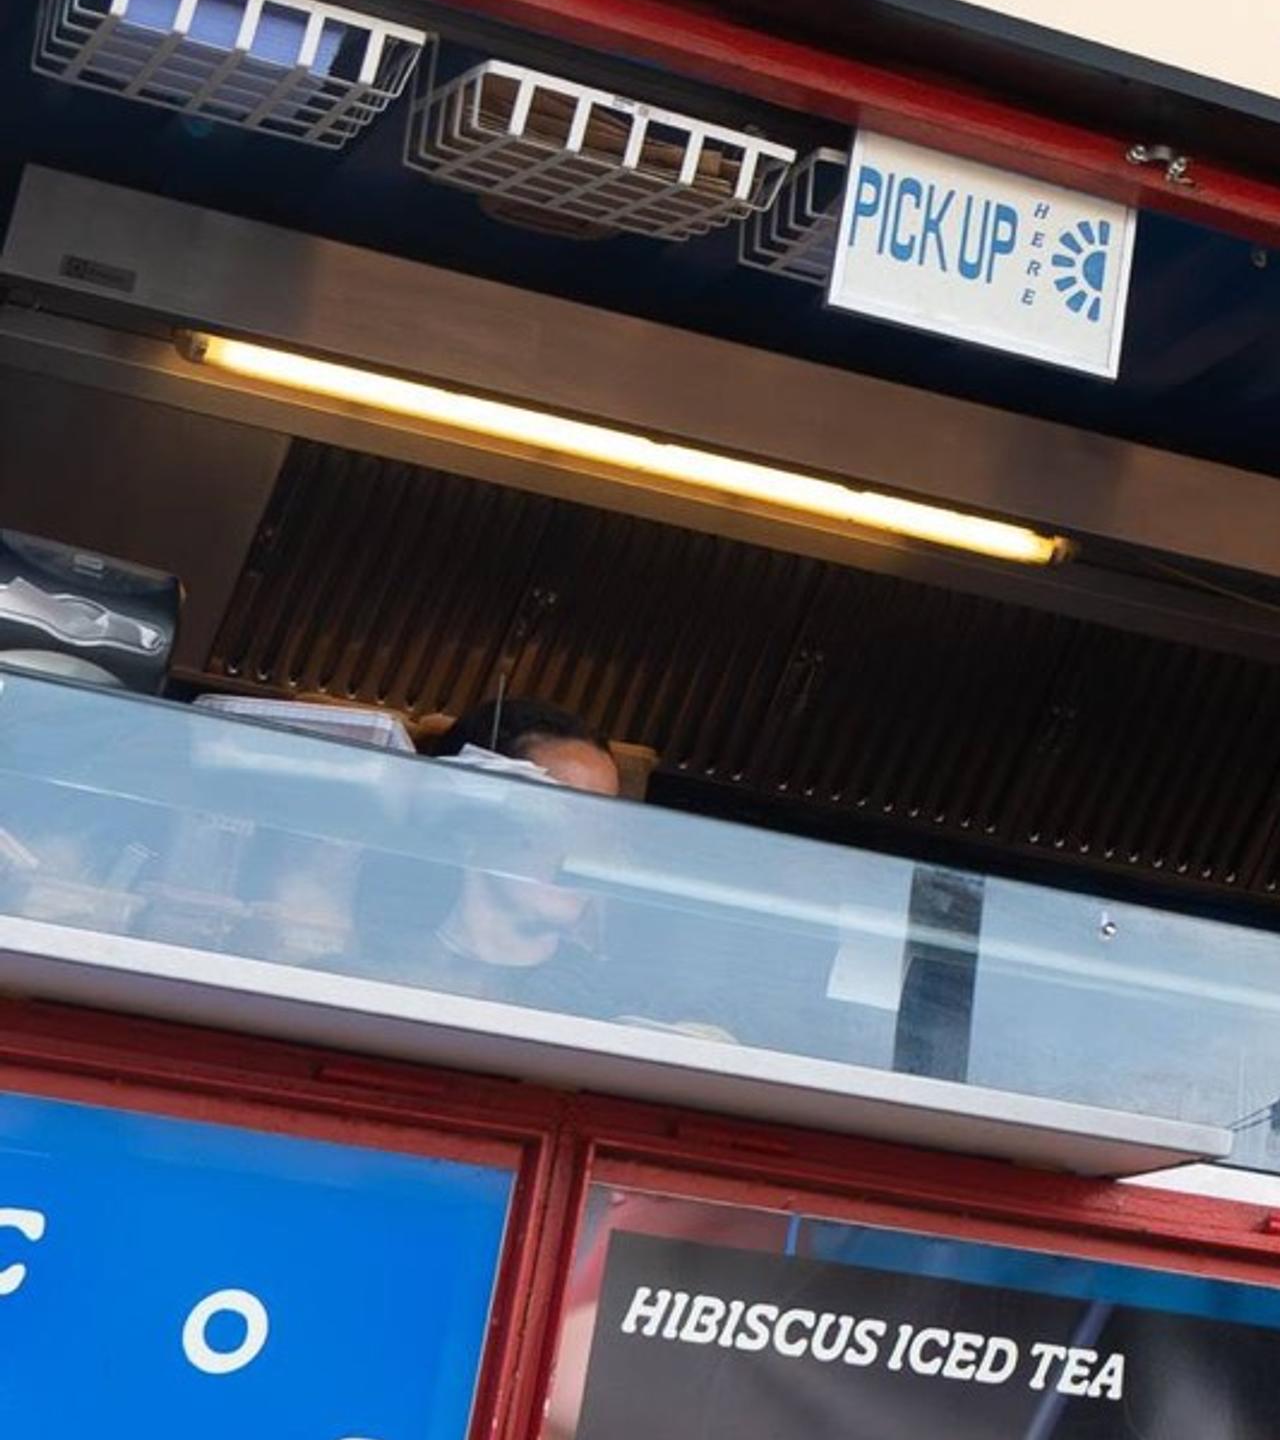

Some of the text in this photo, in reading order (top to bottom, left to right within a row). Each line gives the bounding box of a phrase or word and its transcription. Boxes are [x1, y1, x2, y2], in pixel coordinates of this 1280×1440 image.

[621, 1286, 1126, 1400] HIBISCUS ICED TEA
